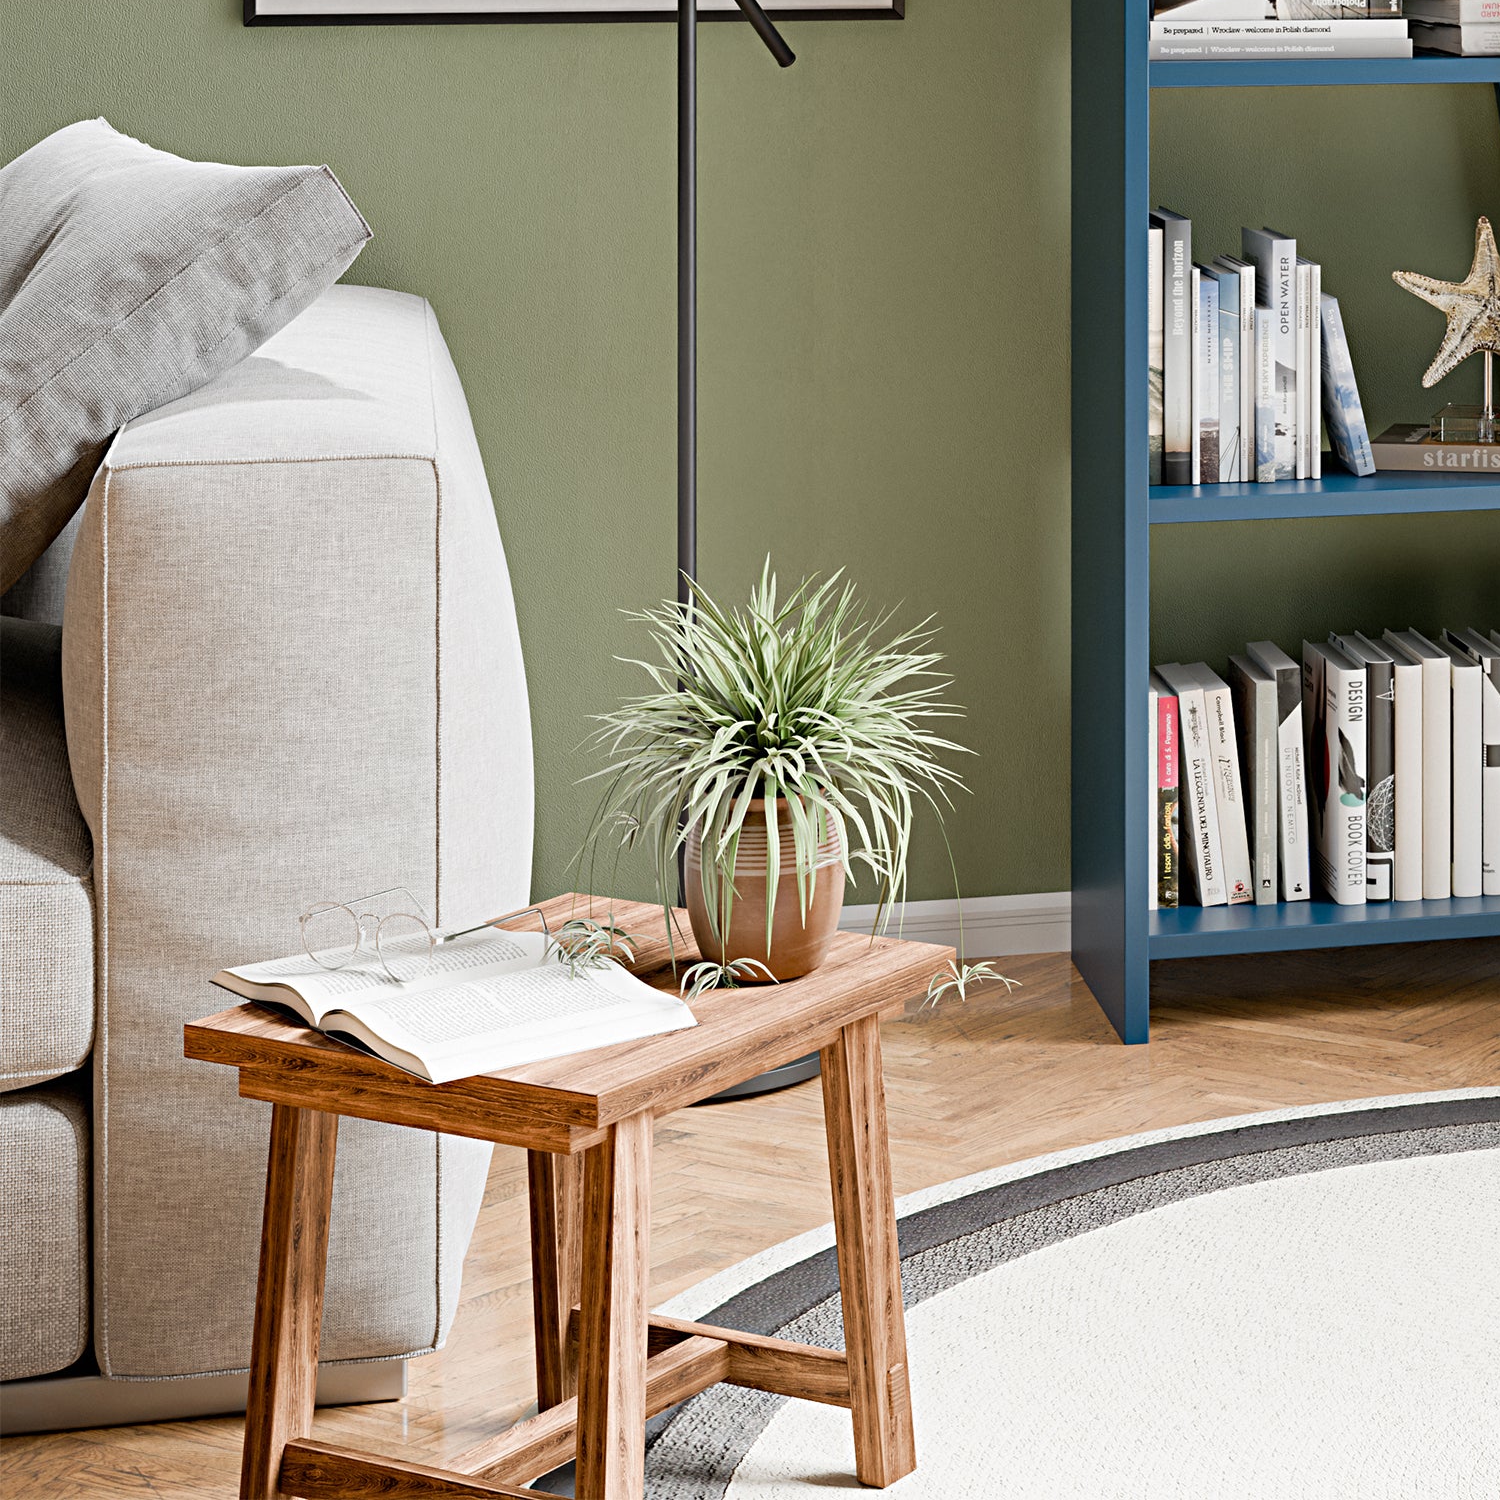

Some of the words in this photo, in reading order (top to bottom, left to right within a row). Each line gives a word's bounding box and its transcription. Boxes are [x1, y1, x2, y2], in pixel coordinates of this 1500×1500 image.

[1163, 26, 1173, 34] Be
[1173, 27, 1204, 35] prepared
[1160, 46, 1170, 54] Be
[1171, 46, 1202, 55] prepared
[1245, 45, 1276, 53] welcome
[1278, 45, 1284, 53] in
[1172, 240, 1184, 278] horizon
[1172, 280, 1184, 296] the
[1280, 257, 1290, 298] WATER
[1172, 299, 1186, 336] Beyond
[1280, 301, 1290, 334] OPEN
[1223, 337, 1234, 371] SHIP
[1262, 319, 1270, 368] EXPERIENCE
[1223, 373, 1234, 402] THE
[1262, 369, 1270, 383] SKY
[1262, 384, 1270, 400] THE
[1216, 695, 1225, 726] Campbell
[1348, 681, 1363, 722] DESIGN
[1192, 758, 1201, 770] LA
[1284, 747, 1292, 761] UN
[1193, 772, 1205, 815] LEGGENDA
[1285, 765, 1293, 801] NUOVO
[1163, 802, 1173, 830] fantasy
[1198, 816, 1208, 832] DEL
[1287, 806, 1295, 845] NEMICO
[1348, 816, 1363, 846] BOOK
[1163, 853, 1172, 873] tesori
[1200, 832, 1214, 881] MINOTAURO
[1348, 850, 1363, 887] COVER
